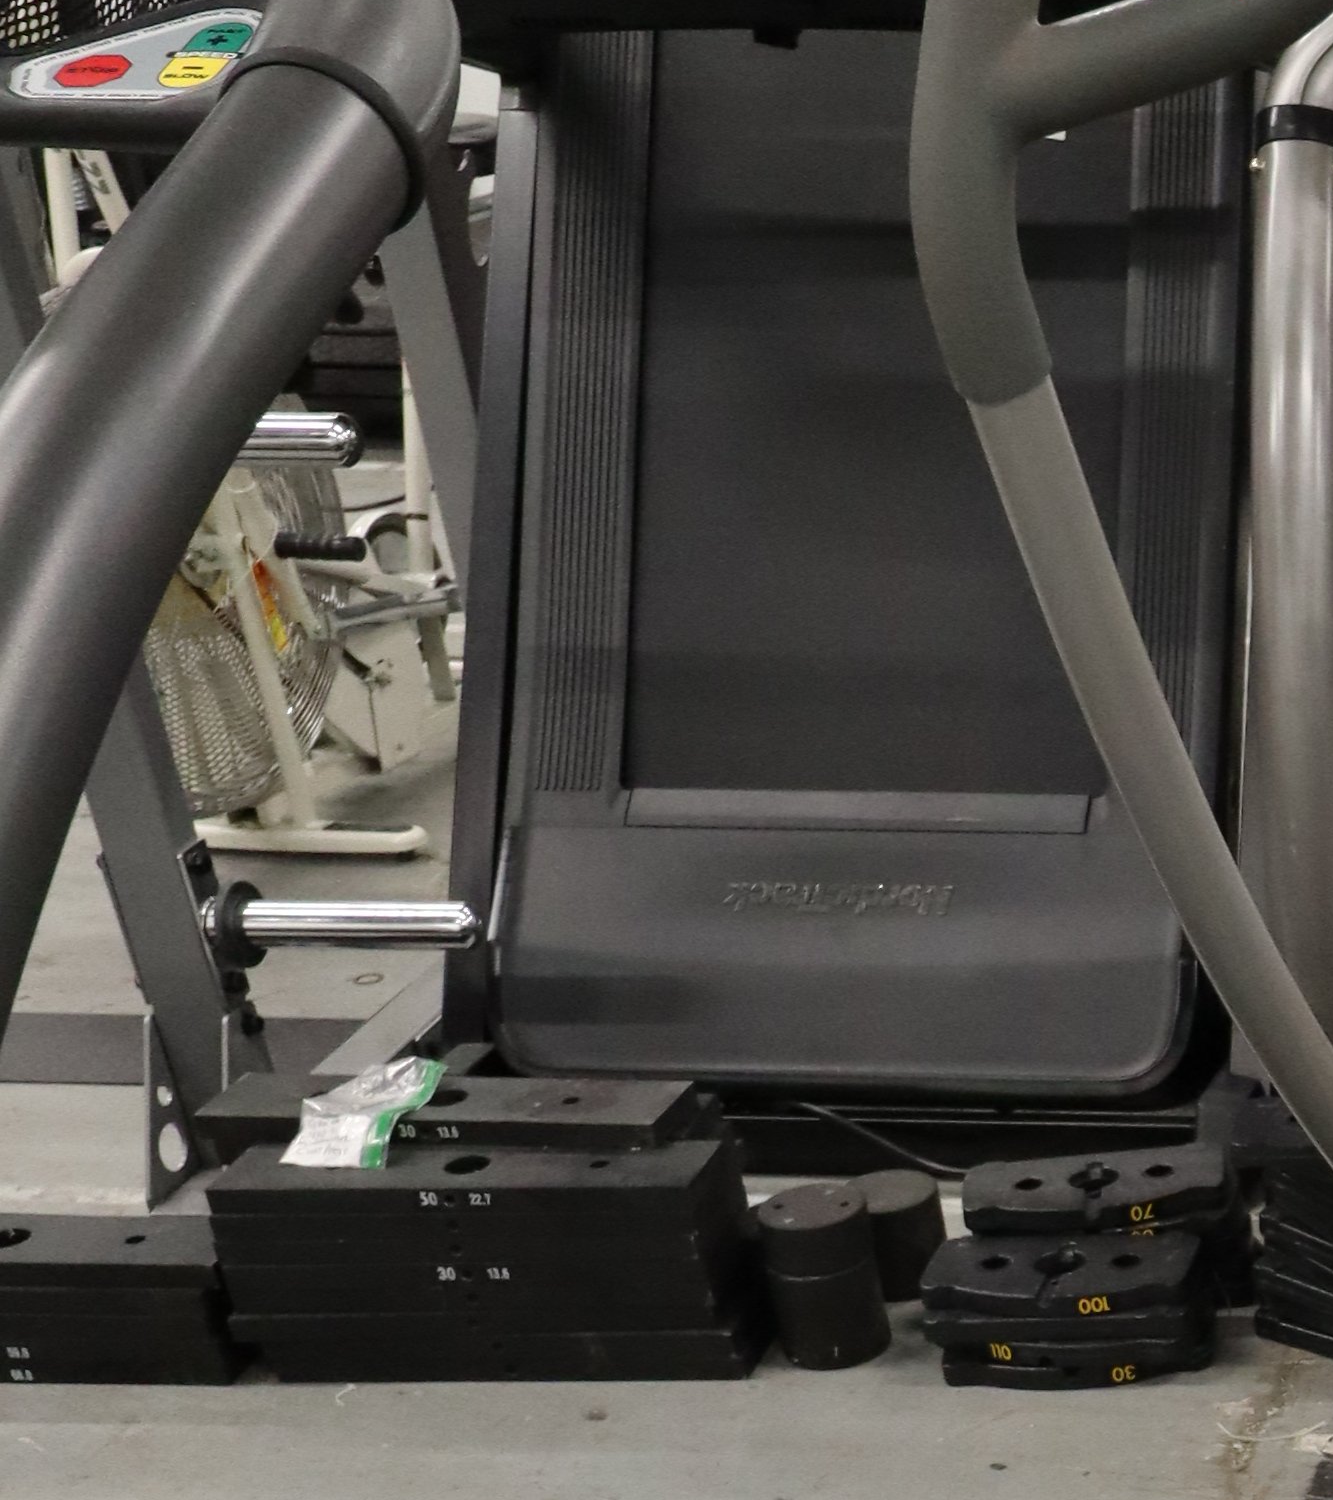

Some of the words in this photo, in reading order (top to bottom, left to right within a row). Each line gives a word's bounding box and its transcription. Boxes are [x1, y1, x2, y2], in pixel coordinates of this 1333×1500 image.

[174, 51, 237, 59] SPEED
[399, 1124, 416, 1138] 30
[419, 1192, 438, 1206] 50
[1130, 1203, 1155, 1222] 70
[436, 1267, 456, 1281] 30
[1078, 1296, 1111, 1315] 100
[1111, 1364, 1136, 1383] 30
